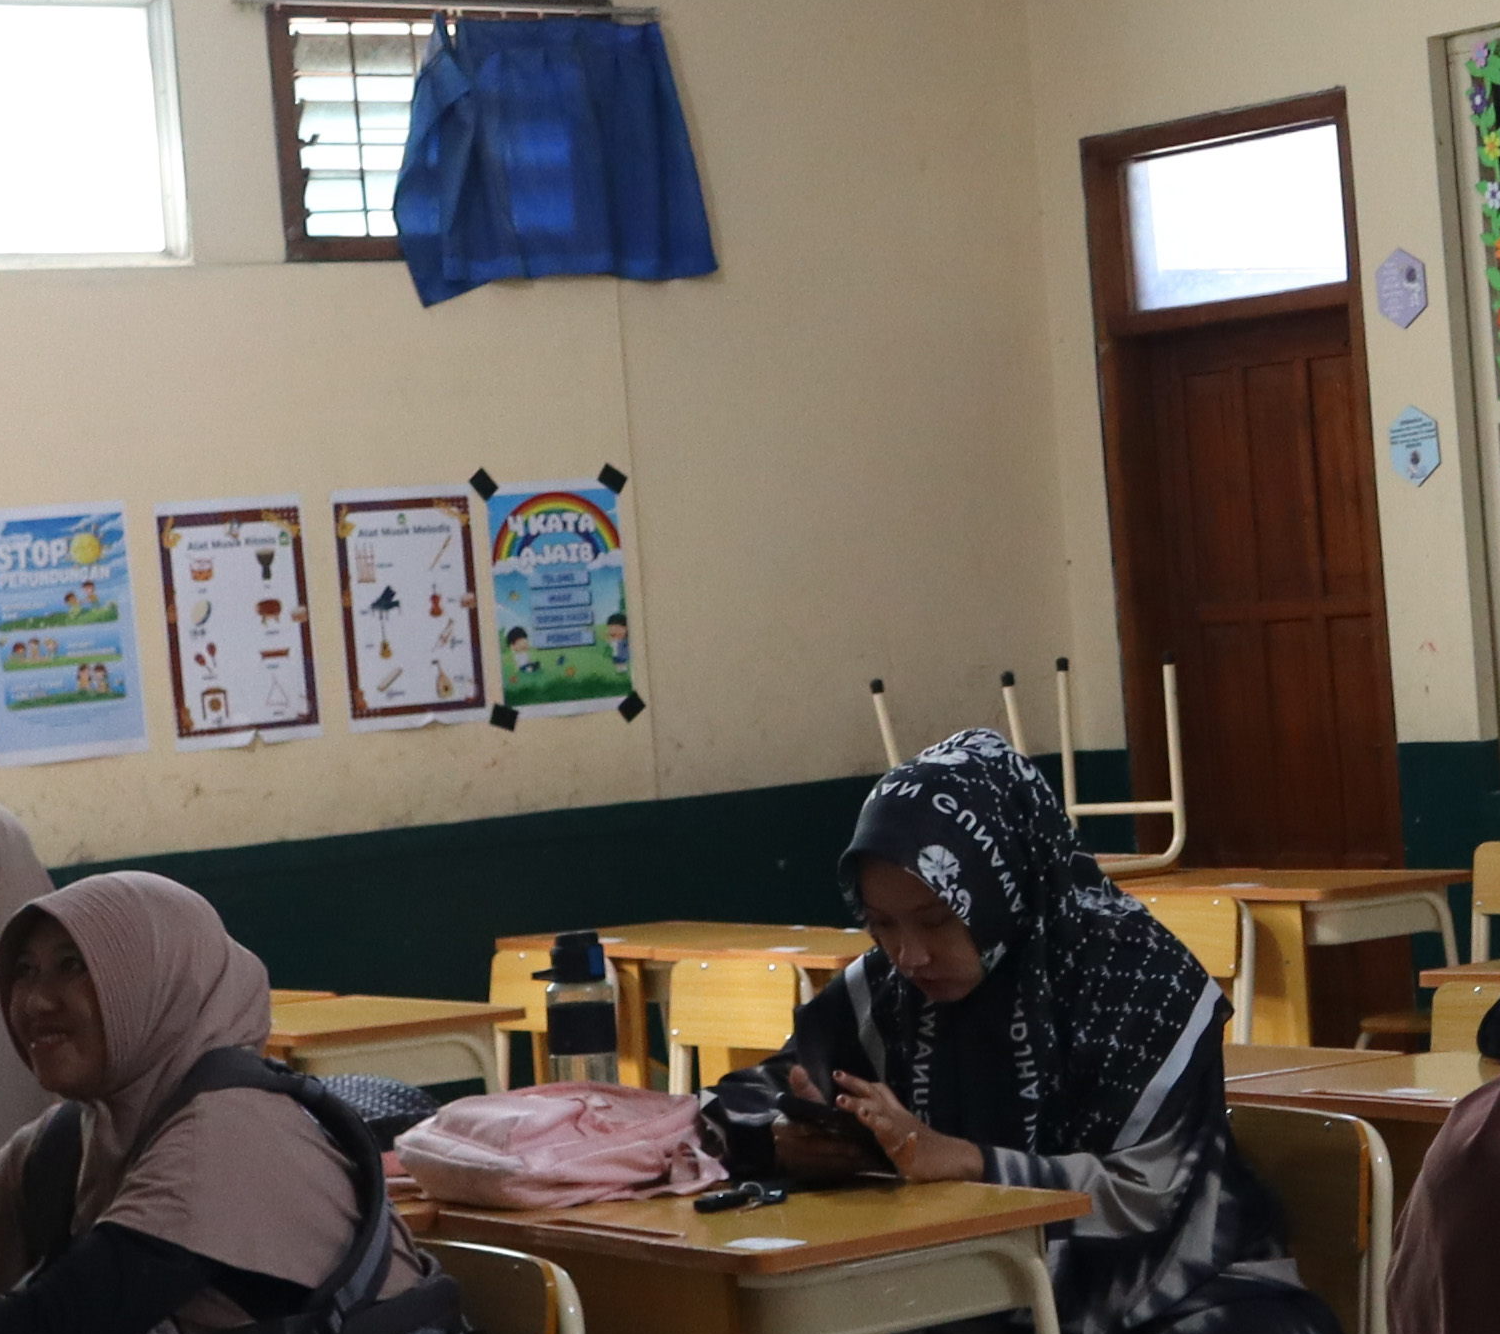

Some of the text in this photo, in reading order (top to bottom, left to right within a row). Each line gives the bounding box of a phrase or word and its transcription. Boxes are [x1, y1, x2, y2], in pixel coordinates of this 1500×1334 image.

[358, 523, 451, 537] Alat Musik Melodis
[507, 512, 596, 537] 4 KATA
[187, 535, 277, 551] Alat Musik Ritmis
[520, 542, 595, 566] AJAIB
